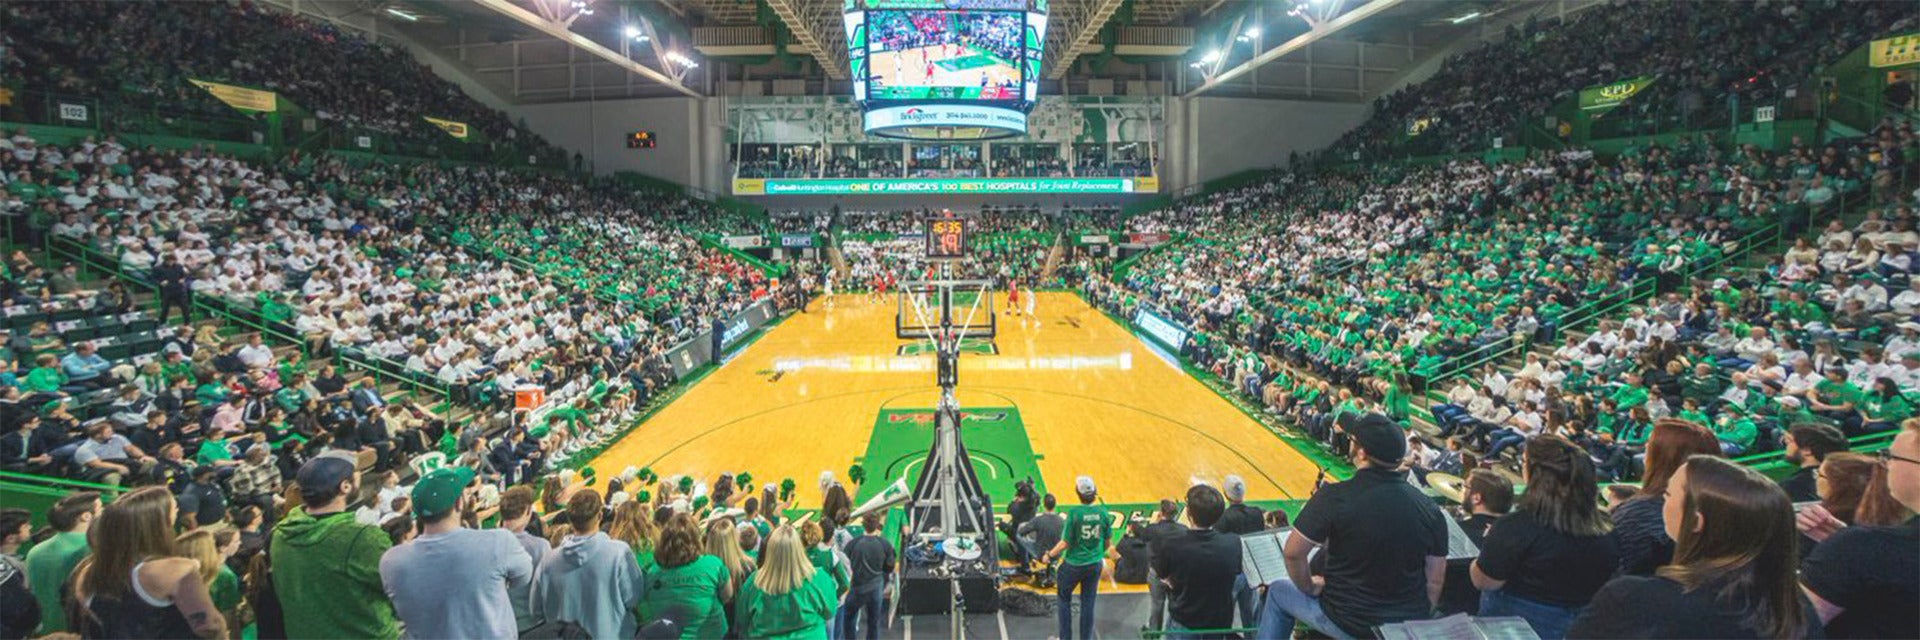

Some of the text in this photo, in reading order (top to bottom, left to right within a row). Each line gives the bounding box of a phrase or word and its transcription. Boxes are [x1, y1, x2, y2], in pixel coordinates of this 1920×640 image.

[63, 107, 84, 118] 102
[849, 183, 869, 192] ONE
[872, 183, 885, 192] OF
[887, 183, 938, 192] AMERICA'S
[941, 183, 958, 191] 100
[960, 183, 984, 191] BEST
[986, 183, 1037, 191] HOSPITALS
[1038, 182, 1050, 191] for
[1051, 182, 1069, 191] Joint
[1072, 182, 1119, 192] Replacement
[1081, 524, 1100, 539] 54
